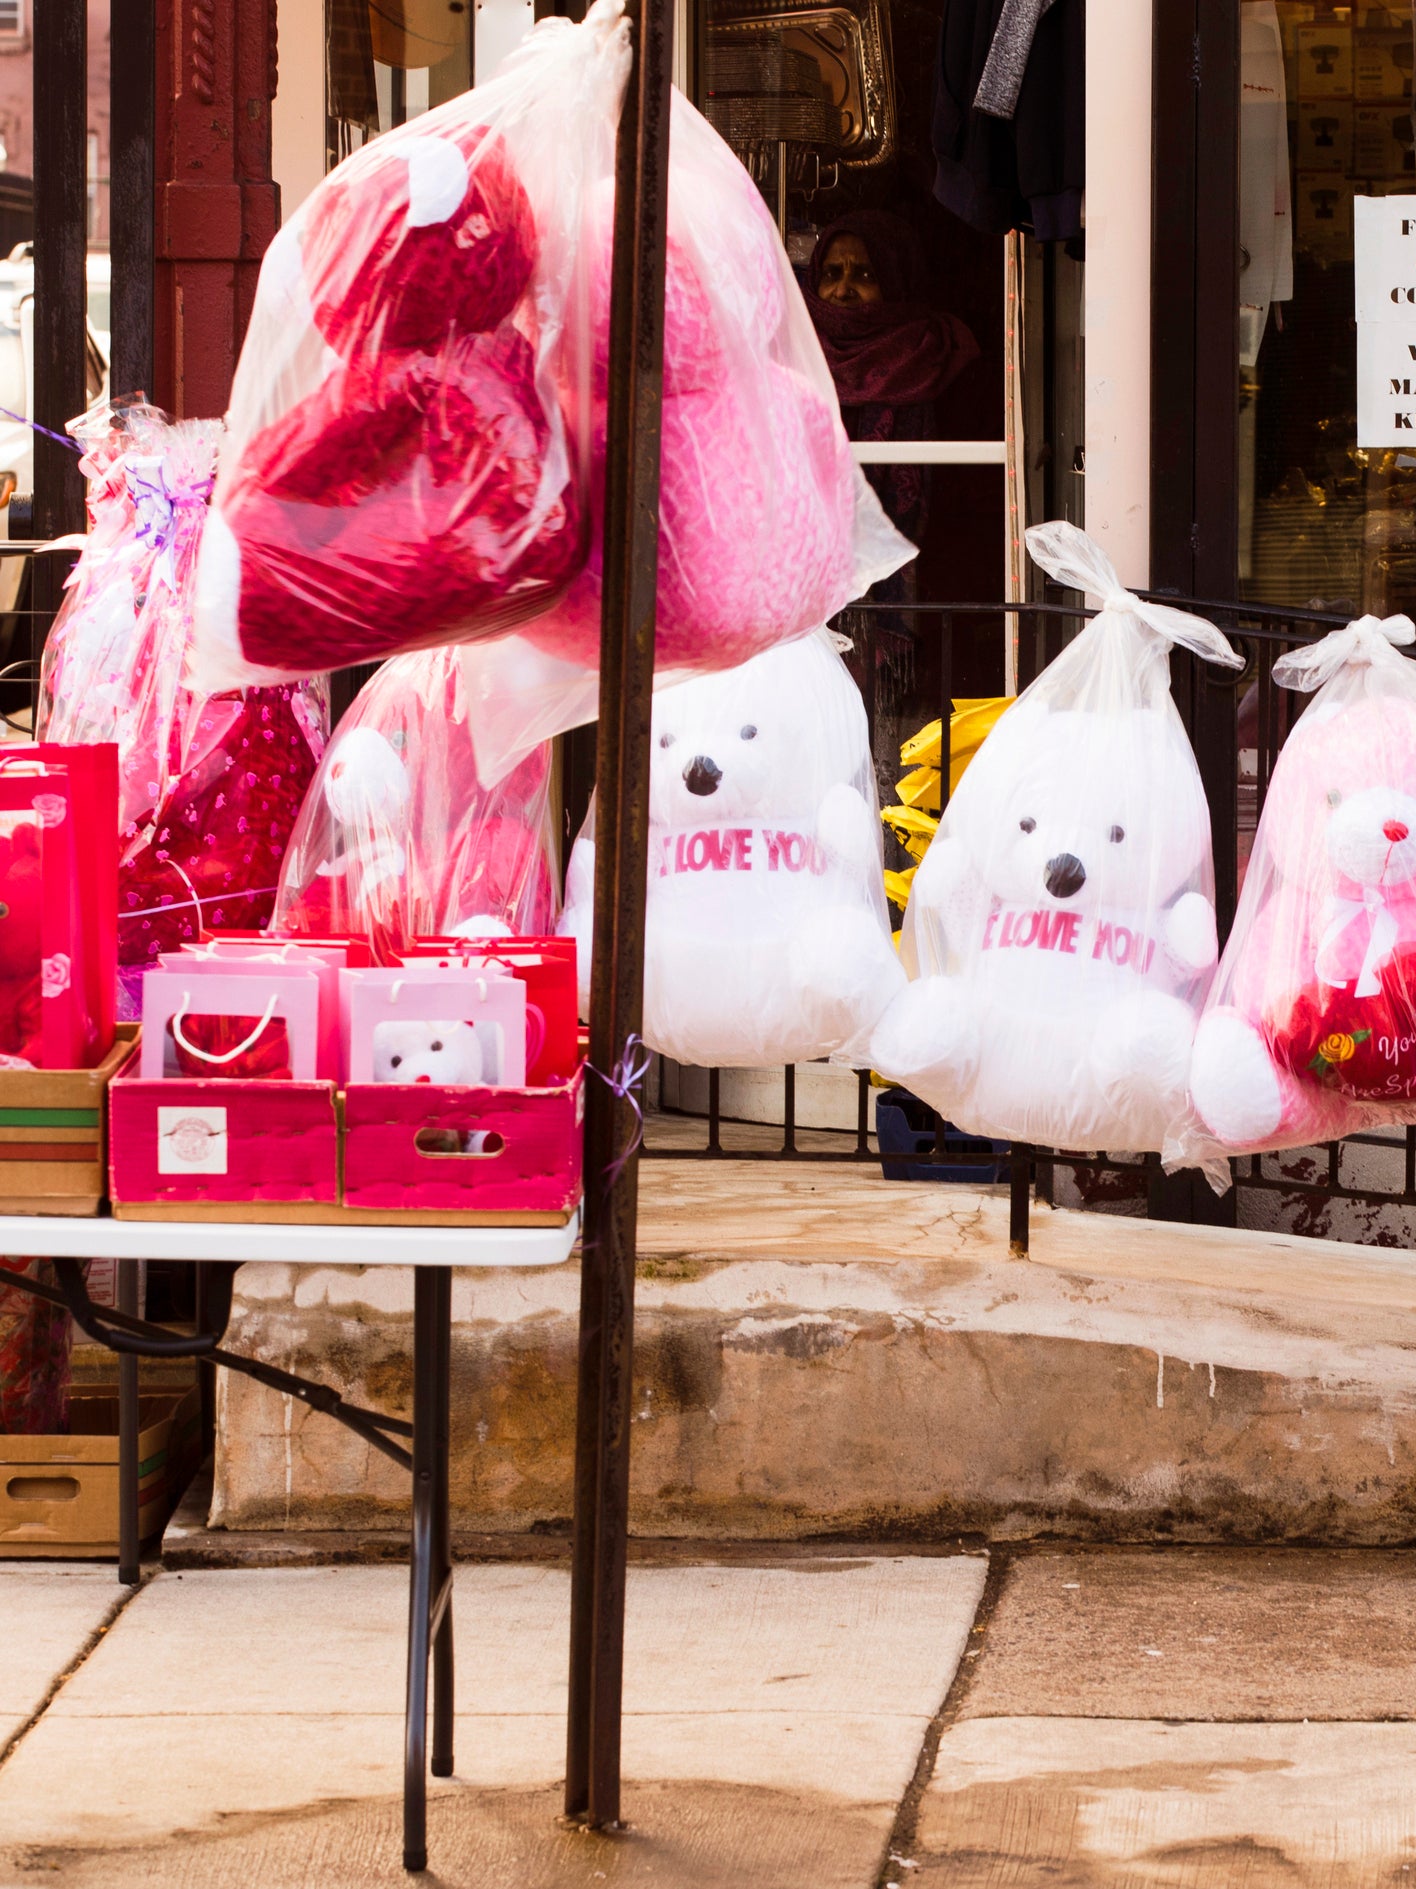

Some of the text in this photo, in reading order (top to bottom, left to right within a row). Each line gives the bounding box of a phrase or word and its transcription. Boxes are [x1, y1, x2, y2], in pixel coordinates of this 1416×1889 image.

[675, 829, 753, 874] LOVE
[761, 829, 829, 877] YOU
[998, 909, 1084, 955] LOVE
[1091, 918, 1157, 976] YOU
